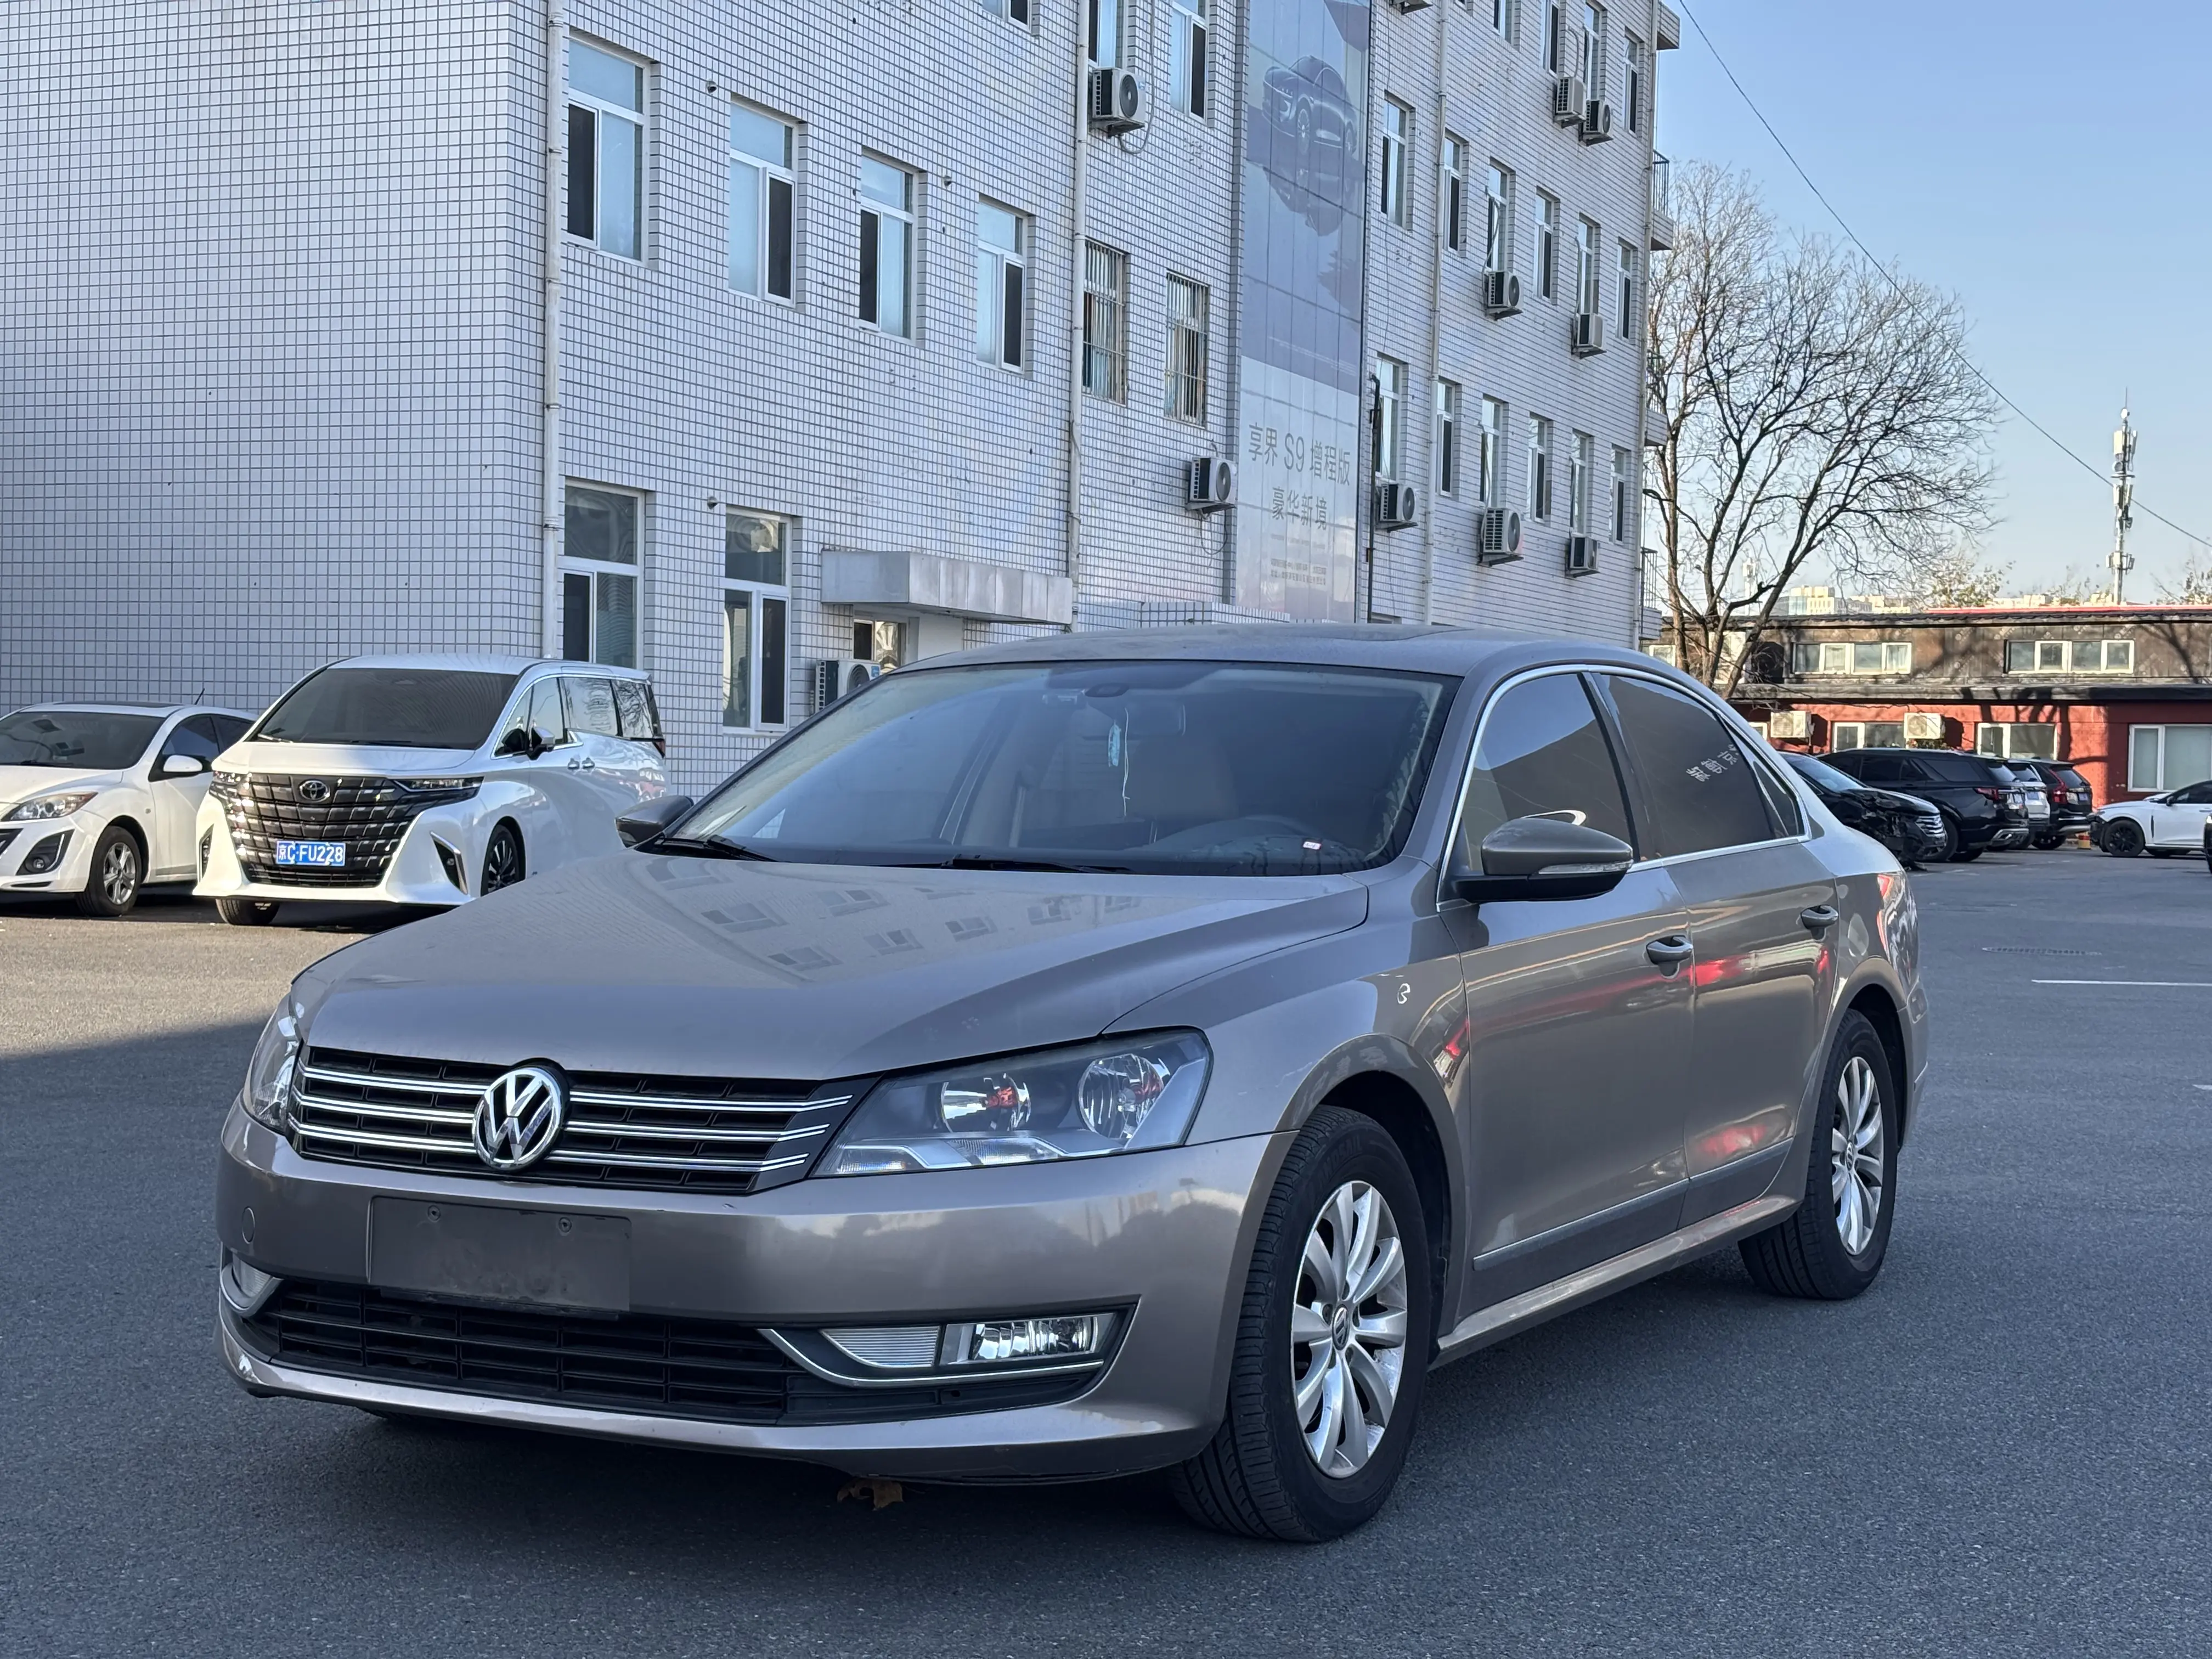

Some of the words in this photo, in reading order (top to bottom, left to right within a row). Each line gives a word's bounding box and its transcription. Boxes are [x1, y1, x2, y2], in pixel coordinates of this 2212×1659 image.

[1248, 422, 1278, 467] 享界
[1284, 433, 1305, 472] S9
[1310, 440, 1351, 486] 增程版
[1272, 486, 1327, 531] 豪华新境
